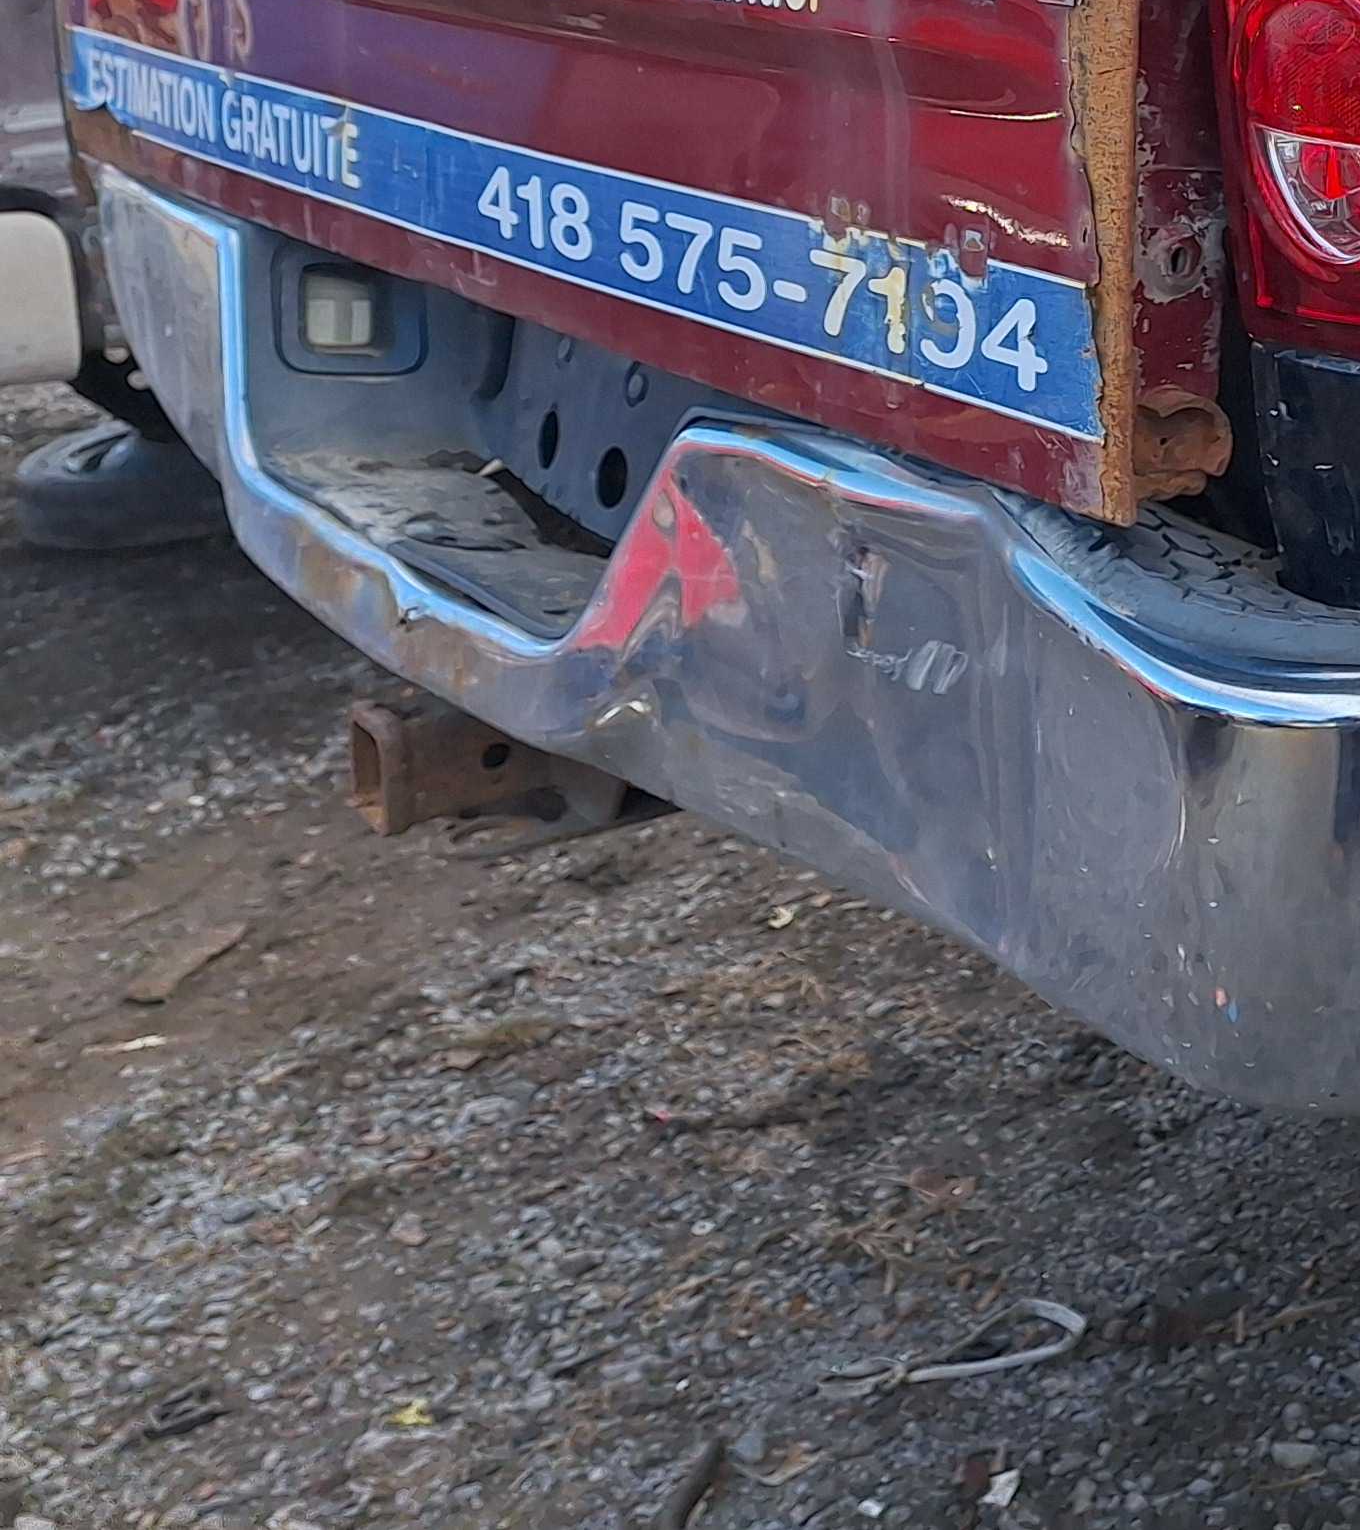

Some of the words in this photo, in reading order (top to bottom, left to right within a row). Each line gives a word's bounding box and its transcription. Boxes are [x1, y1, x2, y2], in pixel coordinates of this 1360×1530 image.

[87, 53, 216, 144] ESTIMATION
[221, 89, 363, 190] GRATUITE
[476, 166, 593, 262] 418
[618, 199, 1049, 393] 575-7194
